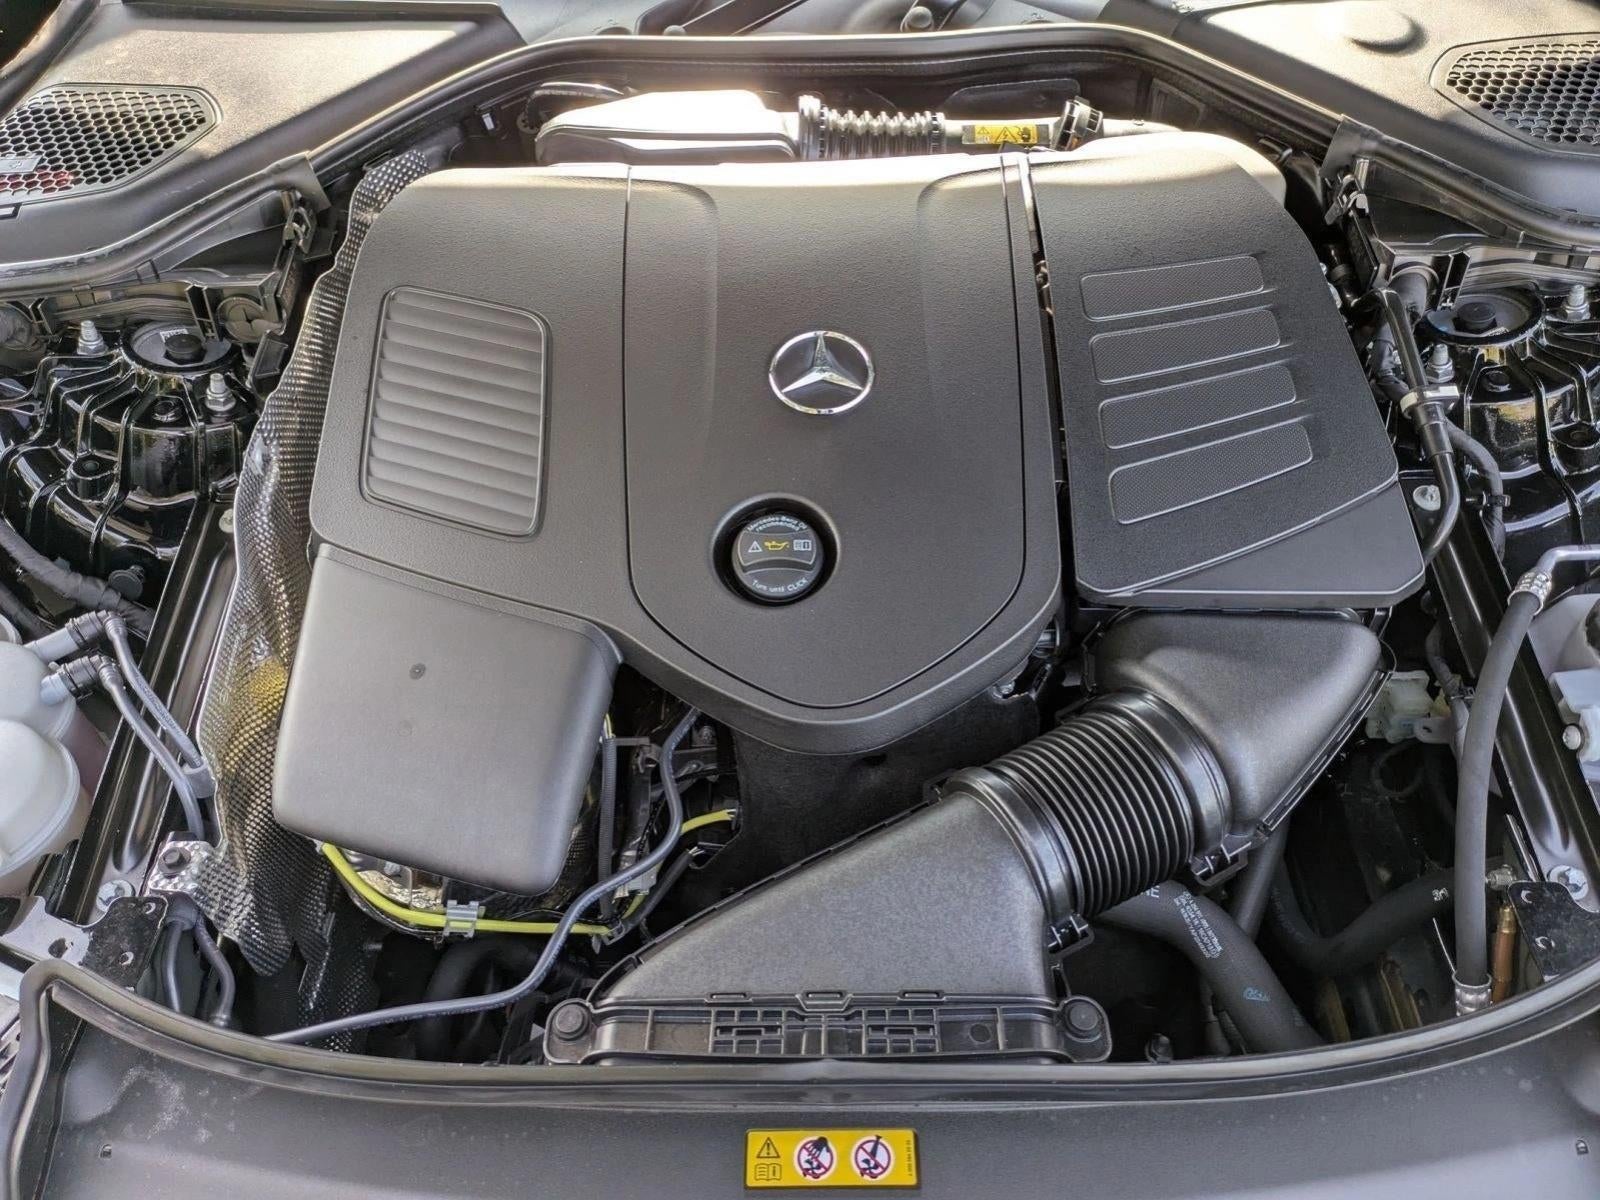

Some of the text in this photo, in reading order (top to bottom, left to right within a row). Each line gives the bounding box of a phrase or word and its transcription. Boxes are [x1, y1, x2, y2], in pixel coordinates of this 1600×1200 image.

[751, 576, 808, 593] Turn until CLICK
